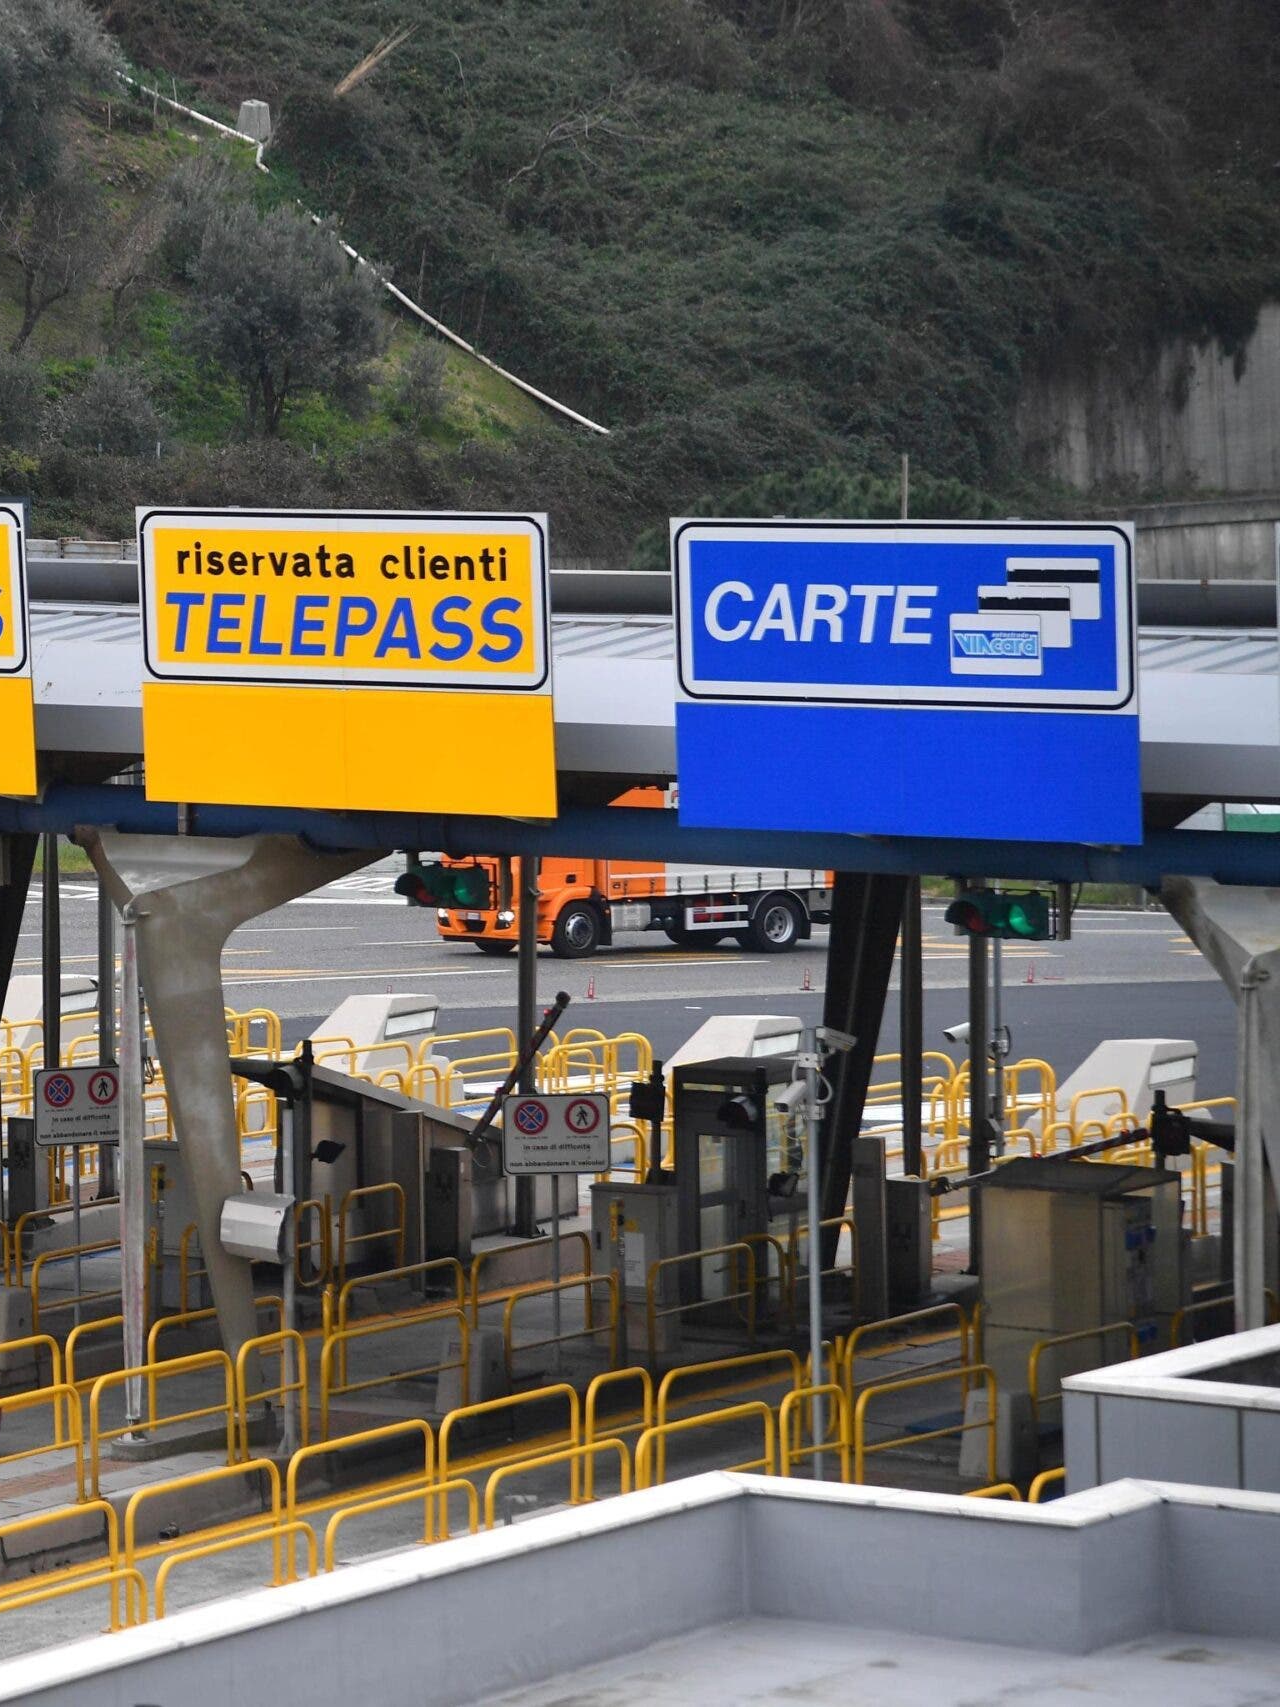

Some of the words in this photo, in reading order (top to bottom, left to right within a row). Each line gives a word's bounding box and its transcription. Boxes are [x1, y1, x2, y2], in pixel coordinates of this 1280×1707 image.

[176, 541, 355, 578] riservata
[379, 545, 508, 582] clienti
[165, 592, 523, 663] TELEPASS
[704, 580, 938, 645] CARTE
[954, 632, 1038, 656] VIAcard
